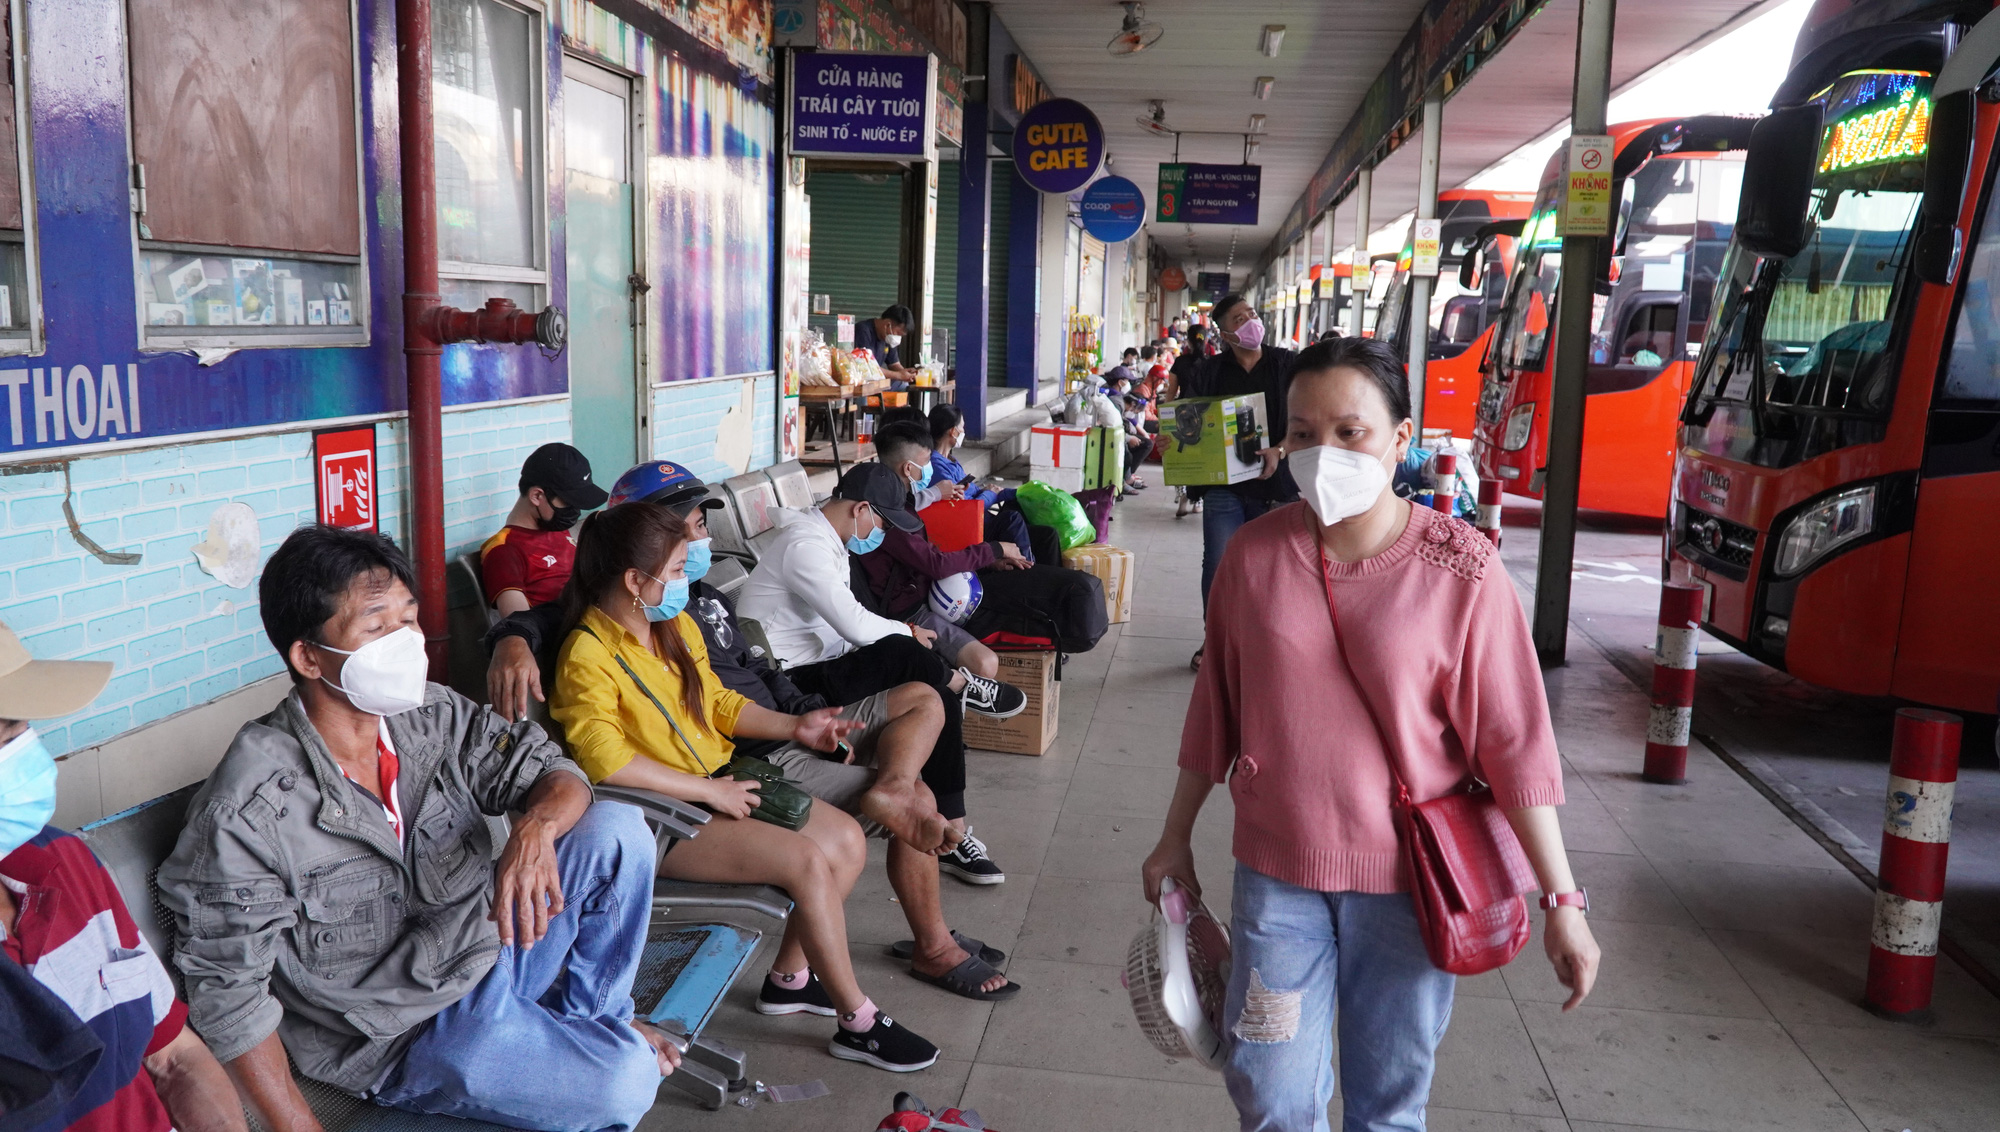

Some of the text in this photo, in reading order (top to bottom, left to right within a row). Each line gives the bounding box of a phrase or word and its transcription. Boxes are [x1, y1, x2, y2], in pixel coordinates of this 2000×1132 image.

[817, 64, 903, 88] CỬA HÀNG
[799, 93, 920, 117] TRÁI CÂY TƯƠI
[798, 125, 828, 139] SINH
[832, 122, 850, 139] TỐ
[861, 126, 896, 141] NƯỚC
[900, 127, 918, 142] ÉP
[1027, 123, 1089, 146] GUTA
[1029, 147, 1088, 172] CAFE
[1162, 193, 1174, 216] 3
[1207, 199, 1239, 207] NGUYÊN
[0, 363, 141, 446] THOẠI
